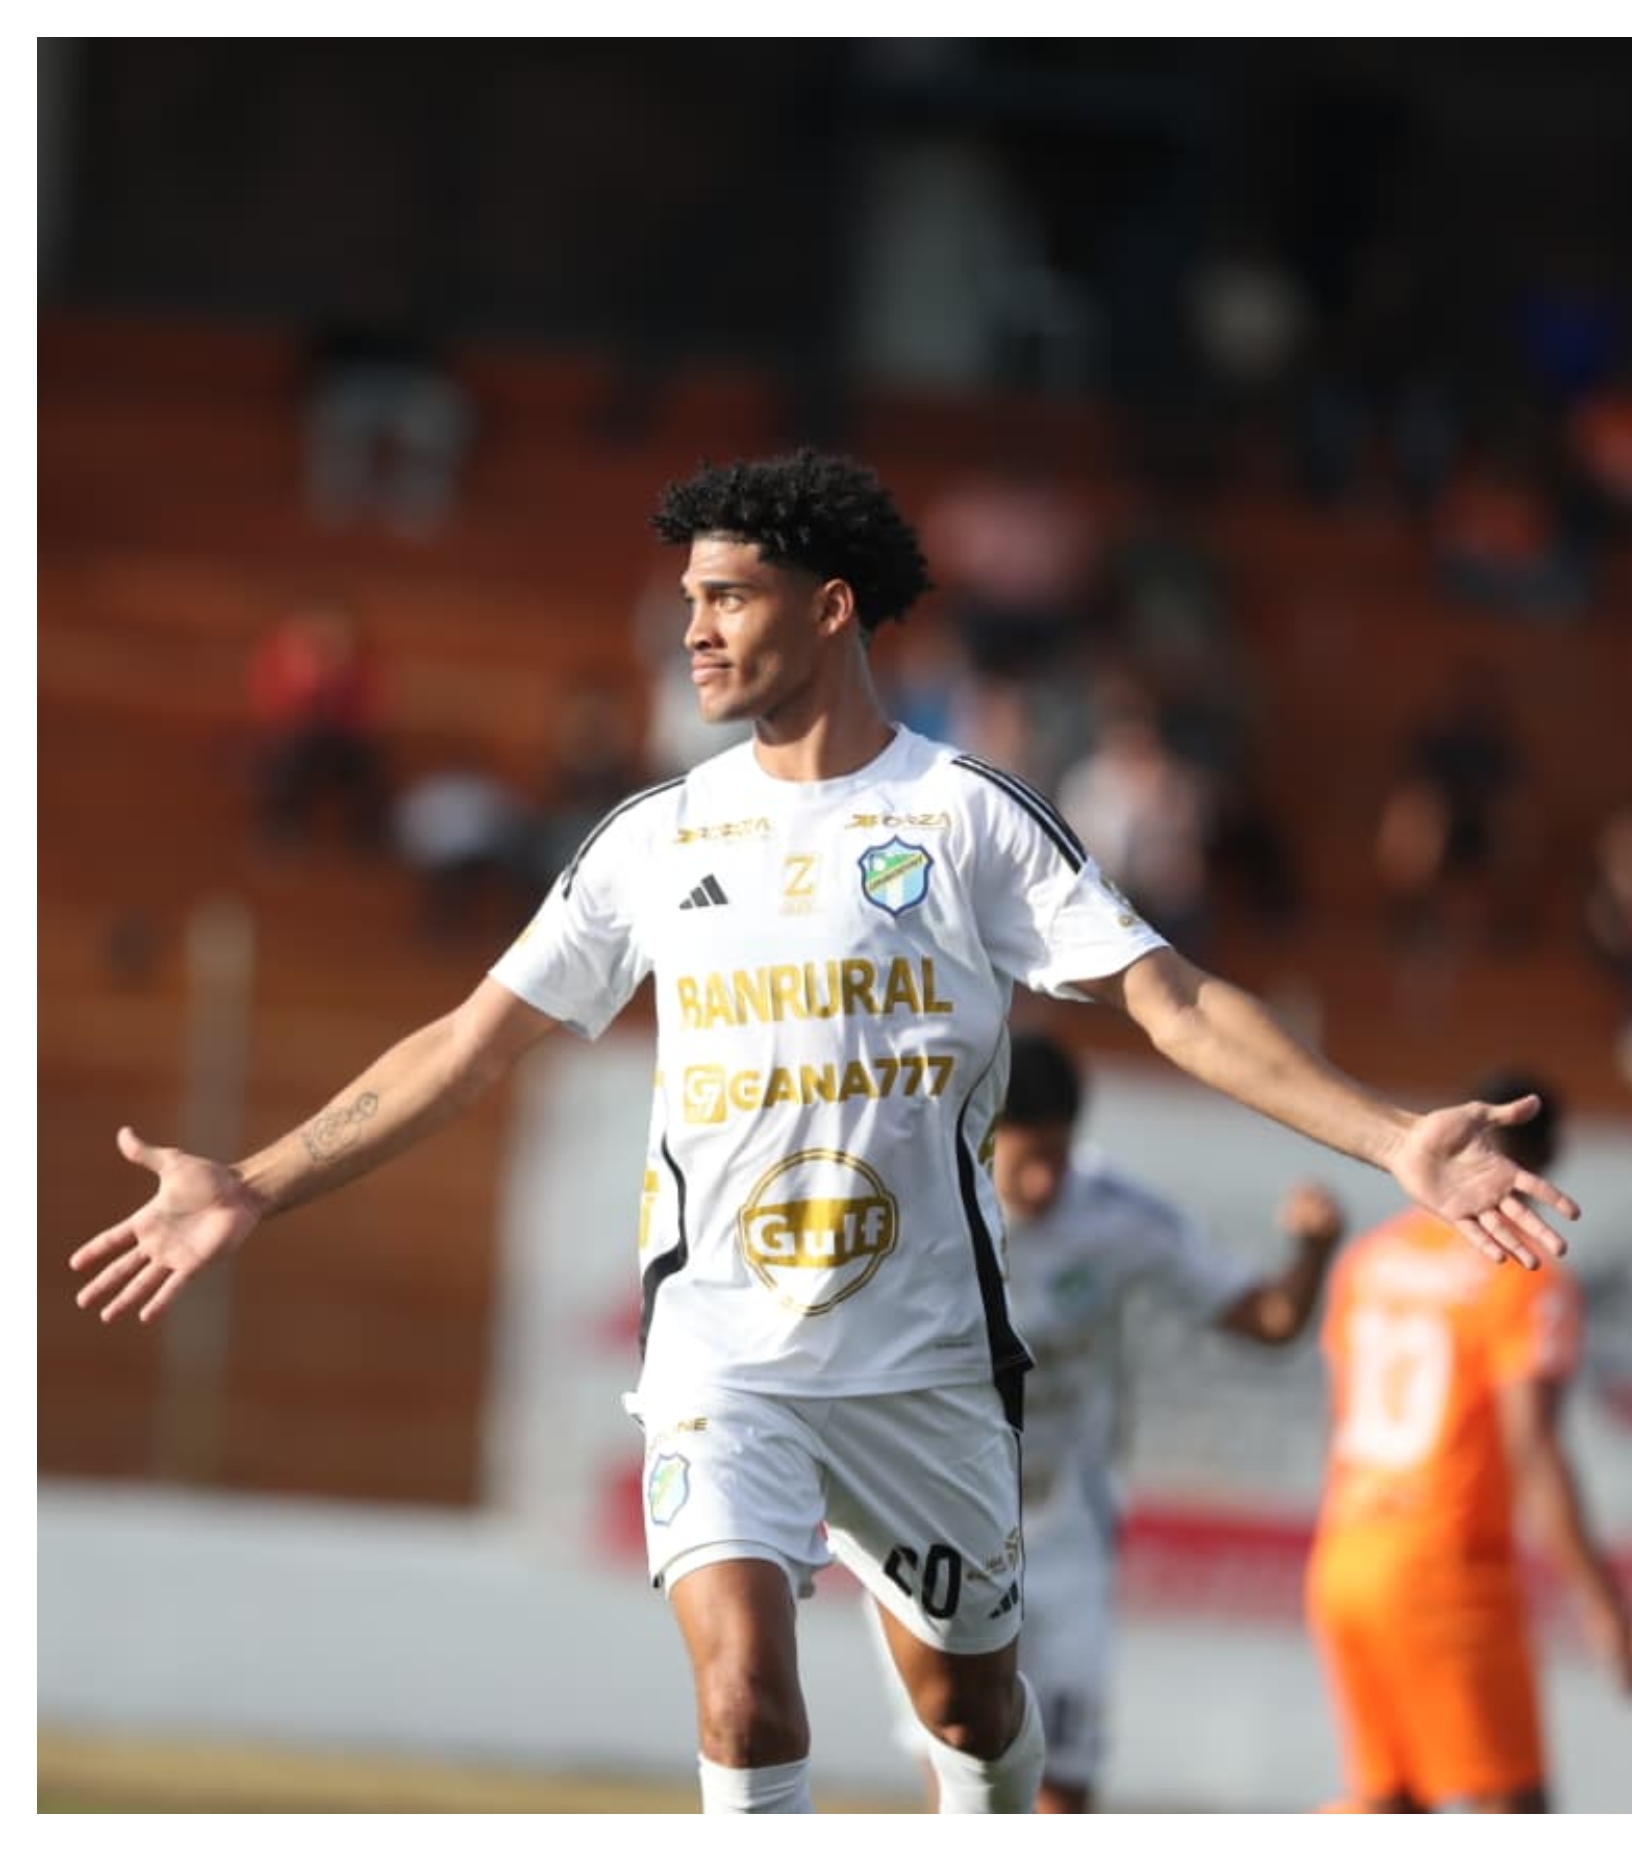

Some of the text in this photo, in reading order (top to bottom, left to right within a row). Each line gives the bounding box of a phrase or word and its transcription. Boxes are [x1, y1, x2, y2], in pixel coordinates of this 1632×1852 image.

[677, 955, 953, 1030] BANRURAL
[728, 1055, 954, 1112] GANA777
[750, 1205, 887, 1257] Gulf
